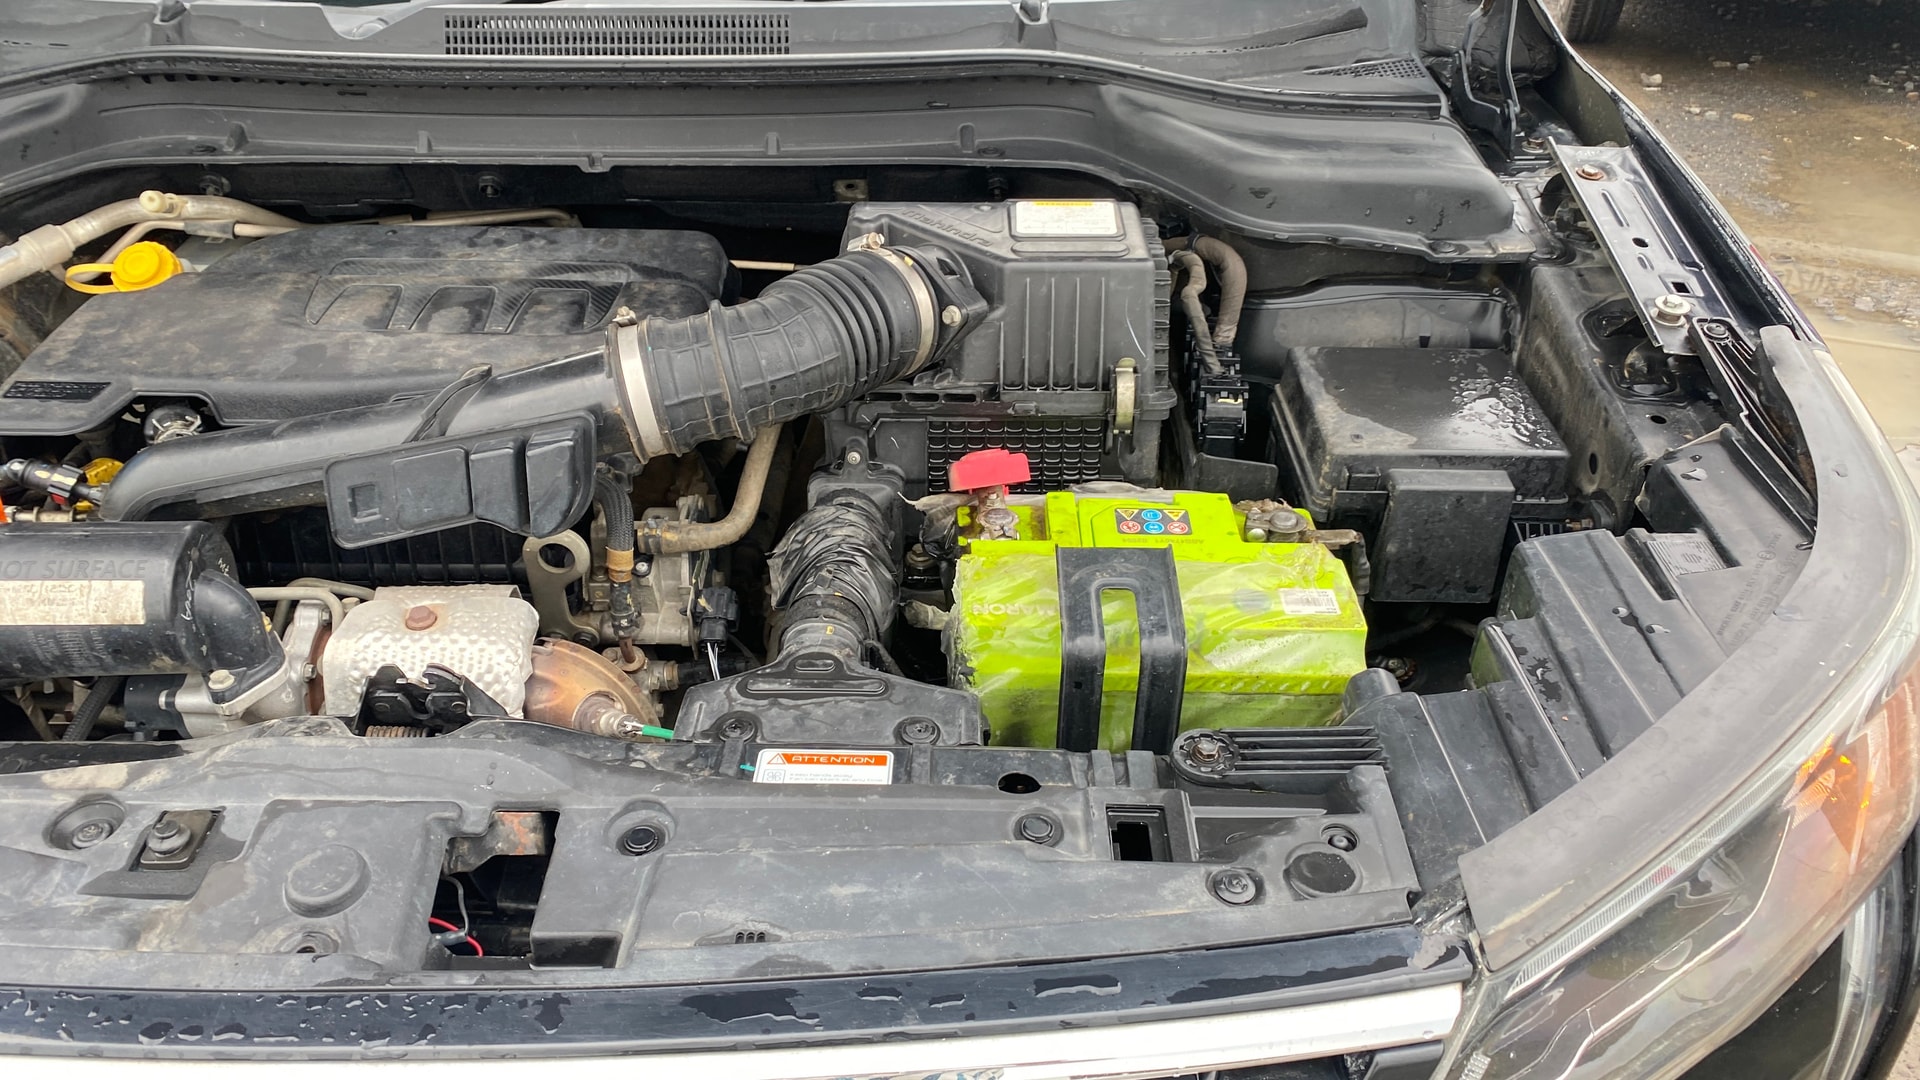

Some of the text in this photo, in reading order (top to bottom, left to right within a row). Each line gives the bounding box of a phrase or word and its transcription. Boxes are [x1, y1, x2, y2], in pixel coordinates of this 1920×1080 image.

[0, 559, 148, 578] OT SURFACE
[972, 602, 1057, 616] MARON
[792, 755, 875, 764] ATTENTION
